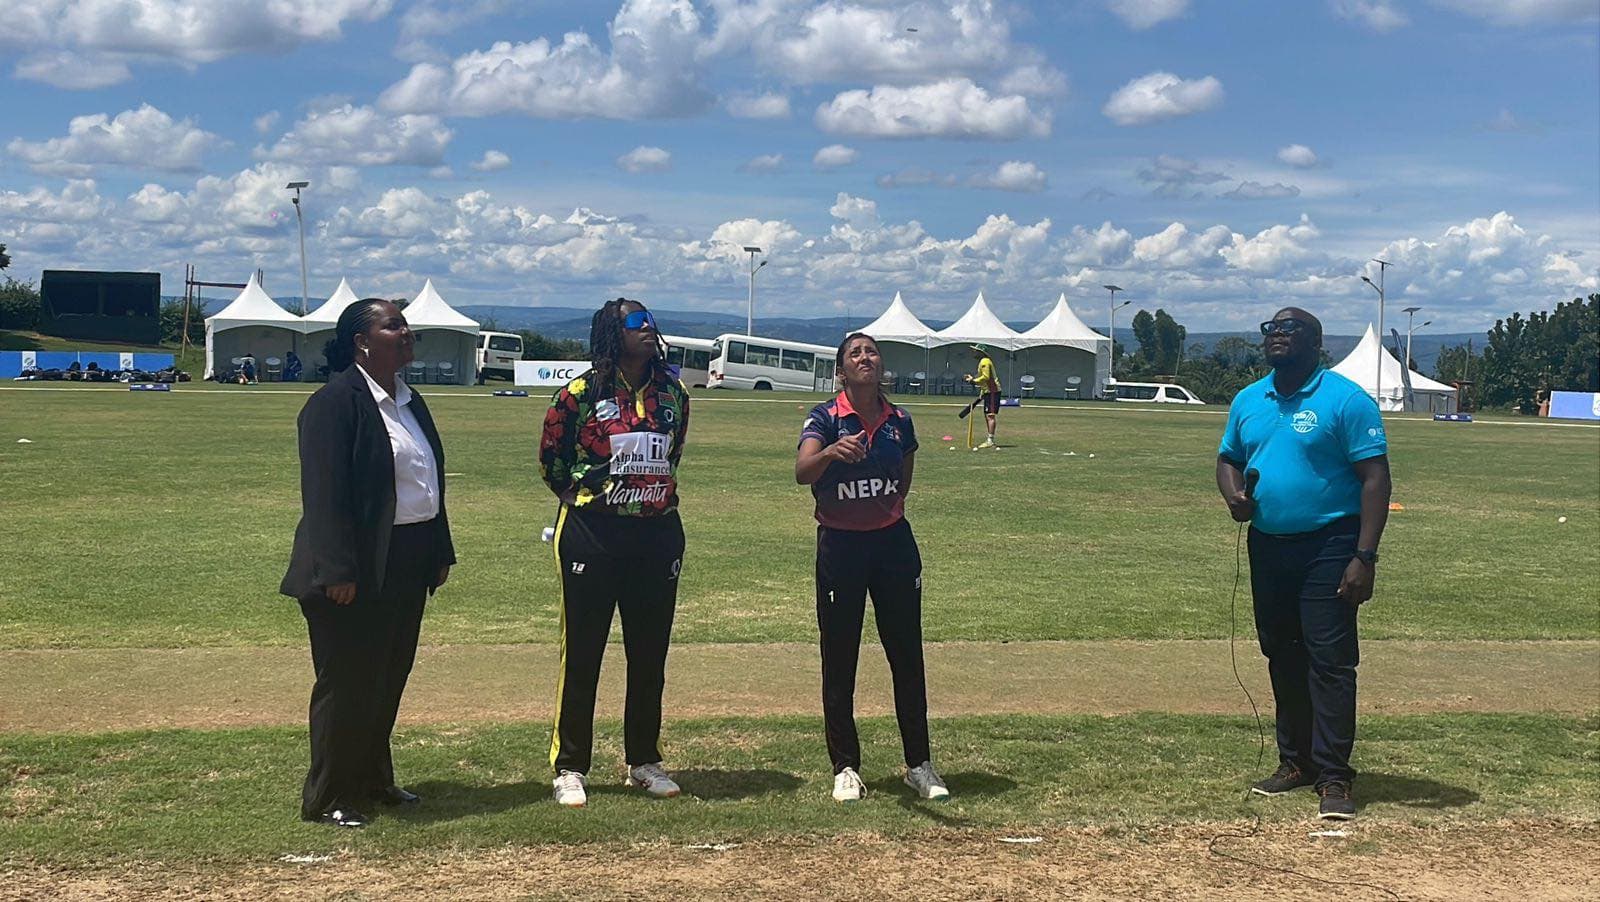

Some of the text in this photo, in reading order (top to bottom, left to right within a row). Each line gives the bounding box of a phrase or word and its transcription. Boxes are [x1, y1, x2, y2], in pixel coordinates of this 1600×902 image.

[552, 368, 574, 379] ICC
[613, 450, 644, 464] Alpha
[605, 479, 671, 505] Vanuatu
